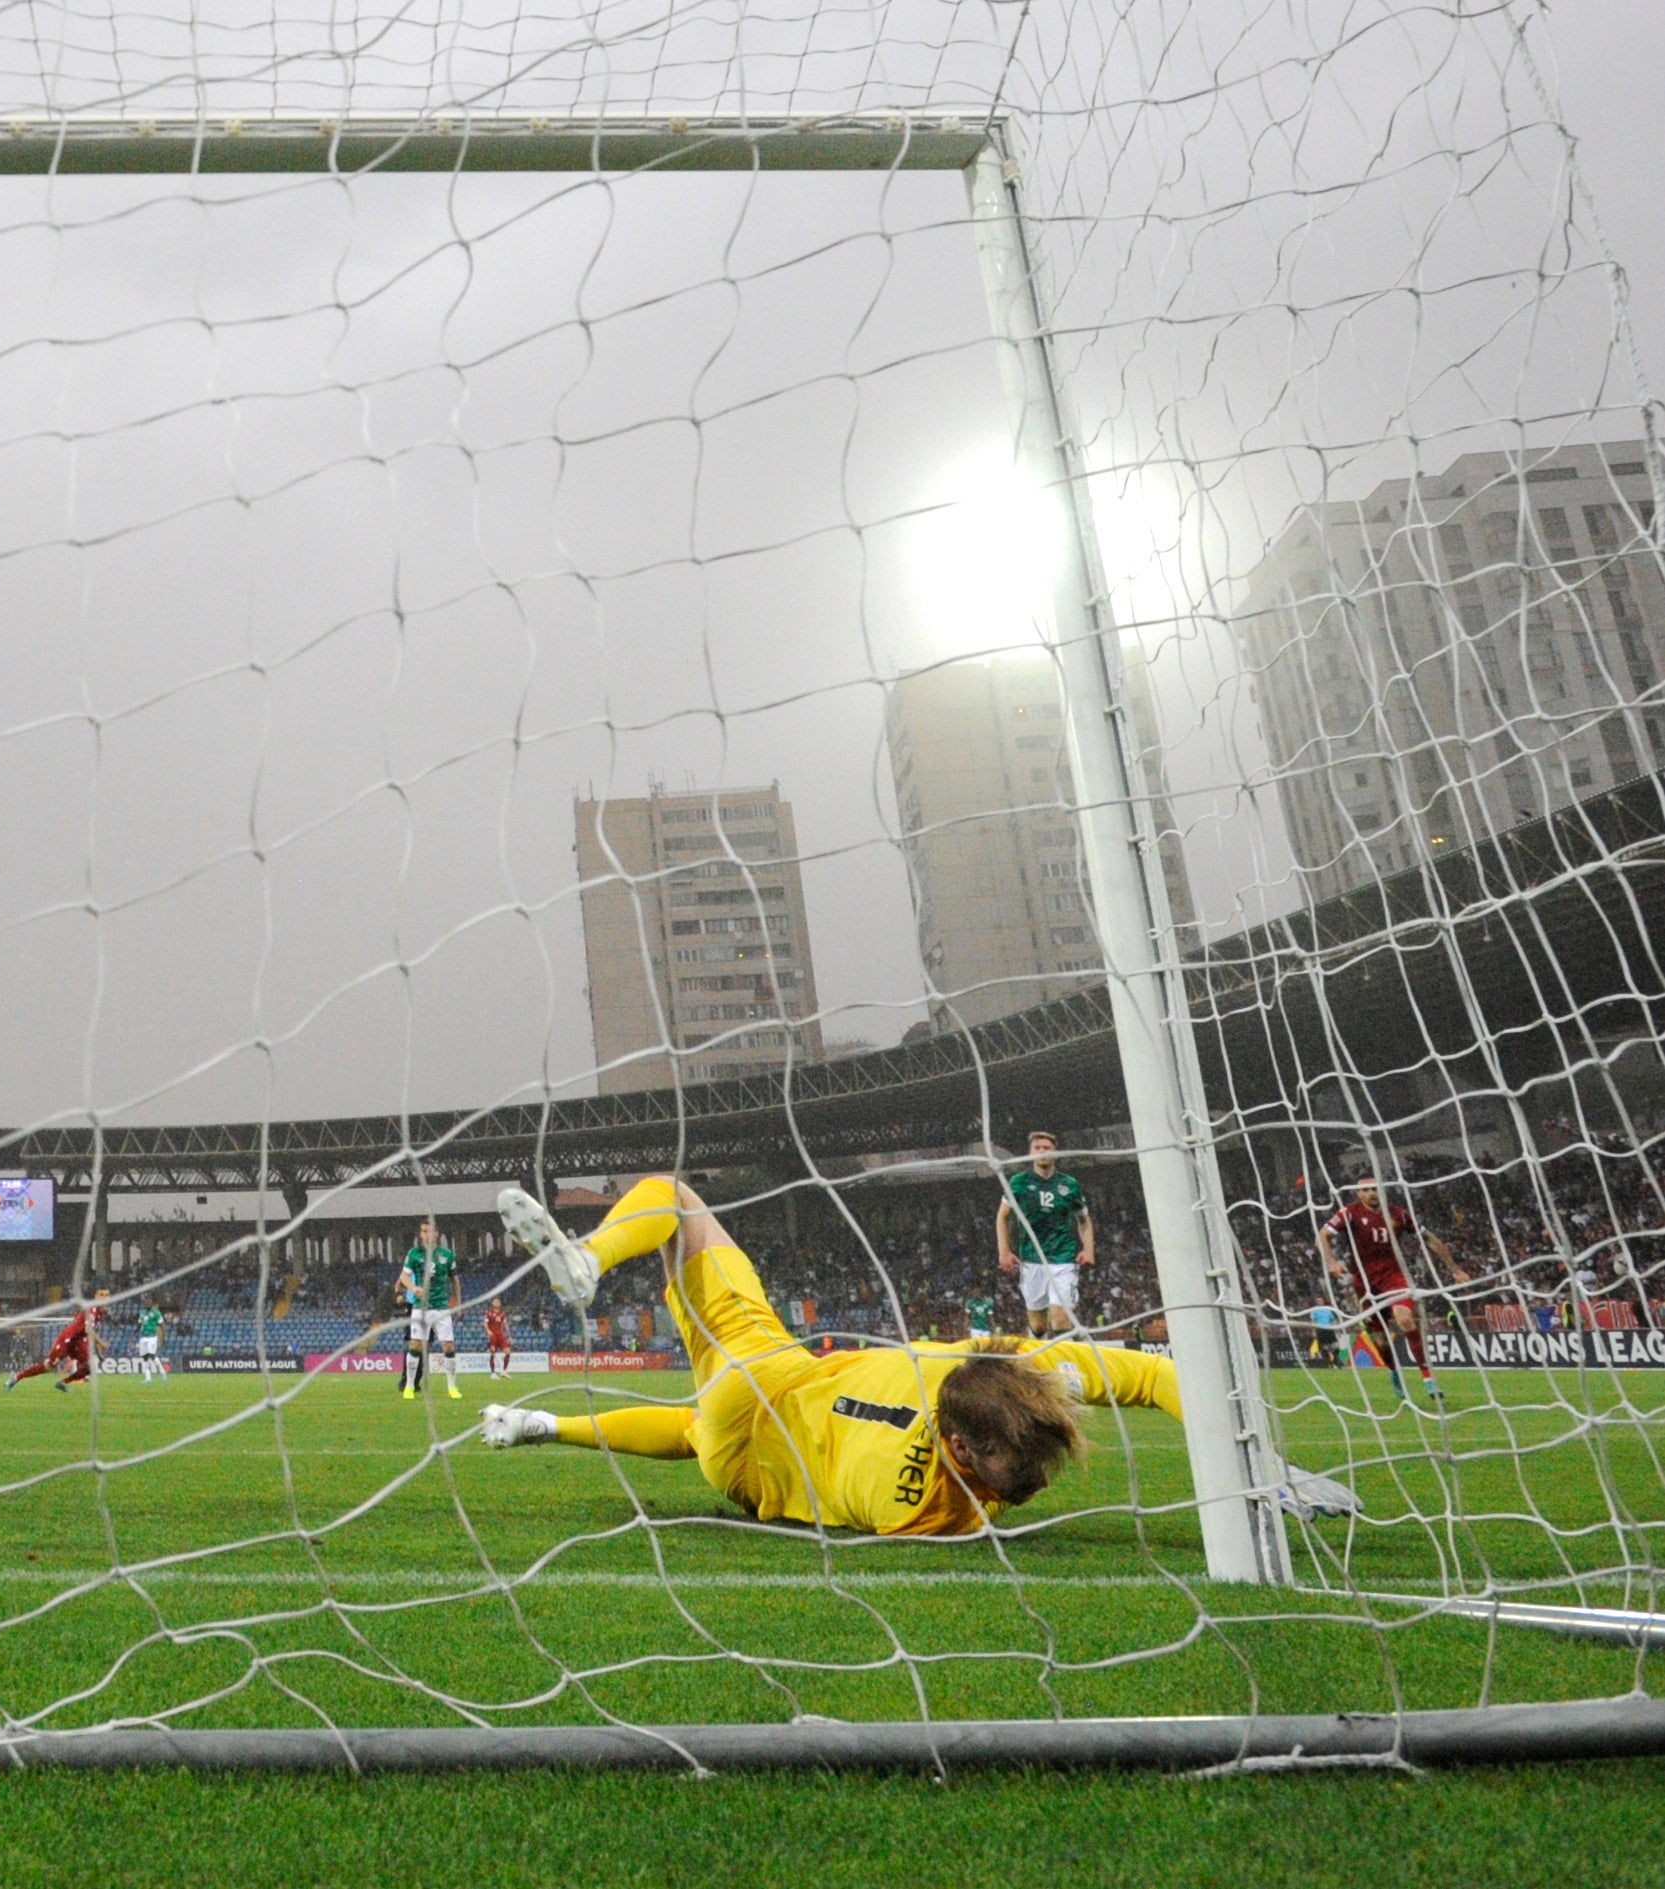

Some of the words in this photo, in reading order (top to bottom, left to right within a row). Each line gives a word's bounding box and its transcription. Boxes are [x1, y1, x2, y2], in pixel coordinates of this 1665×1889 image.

[1039, 1190, 1055, 1208] 12
[1371, 1227, 1388, 1243] 13
[1468, 1332, 1586, 1363] NATIONS
[189, 1360, 213, 1369] UEFA
[215, 1360, 257, 1369] NATIONS
[259, 1360, 297, 1369] LEAGUE
[352, 1357, 393, 1371] vbet
[832, 1395, 919, 1431] 1
